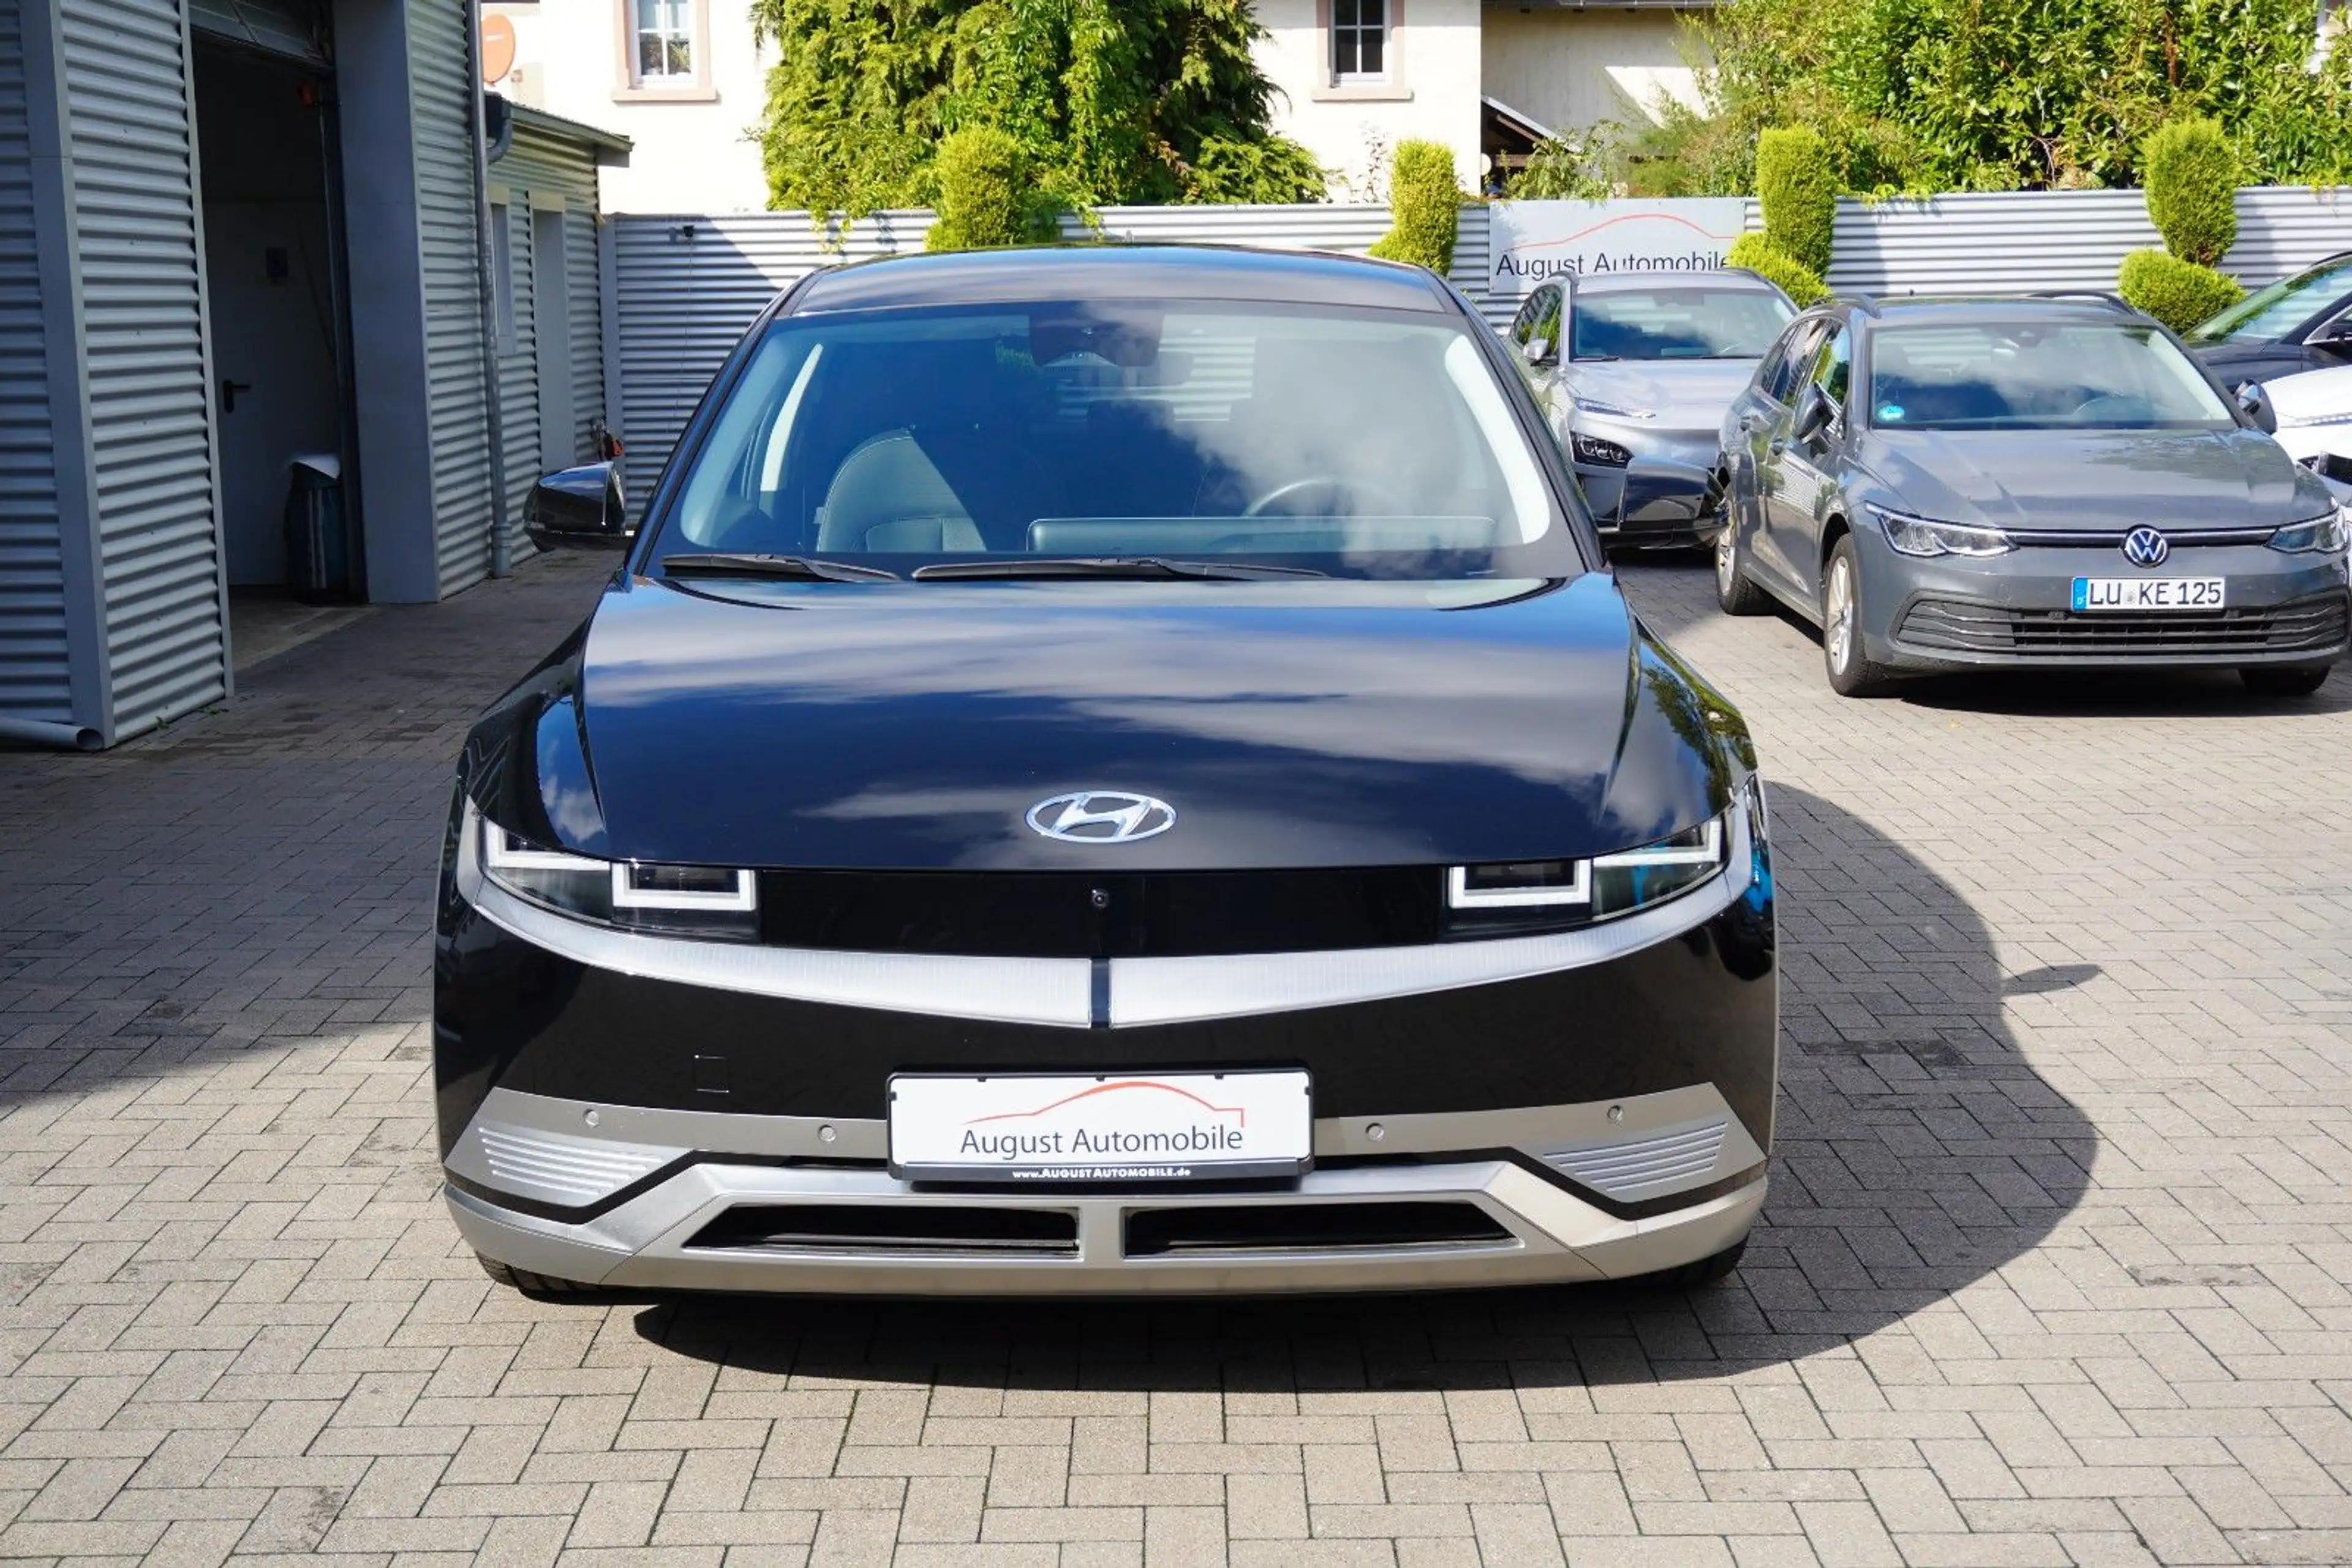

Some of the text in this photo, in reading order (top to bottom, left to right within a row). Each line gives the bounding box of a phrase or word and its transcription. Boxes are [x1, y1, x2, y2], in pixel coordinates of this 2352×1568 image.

[1496, 254, 1584, 281] August
[2089, 582, 2121, 605] LU
[2139, 582, 2169, 605] KE
[2176, 581, 2222, 605] 125
[960, 1124, 1243, 1161] August Automobile
